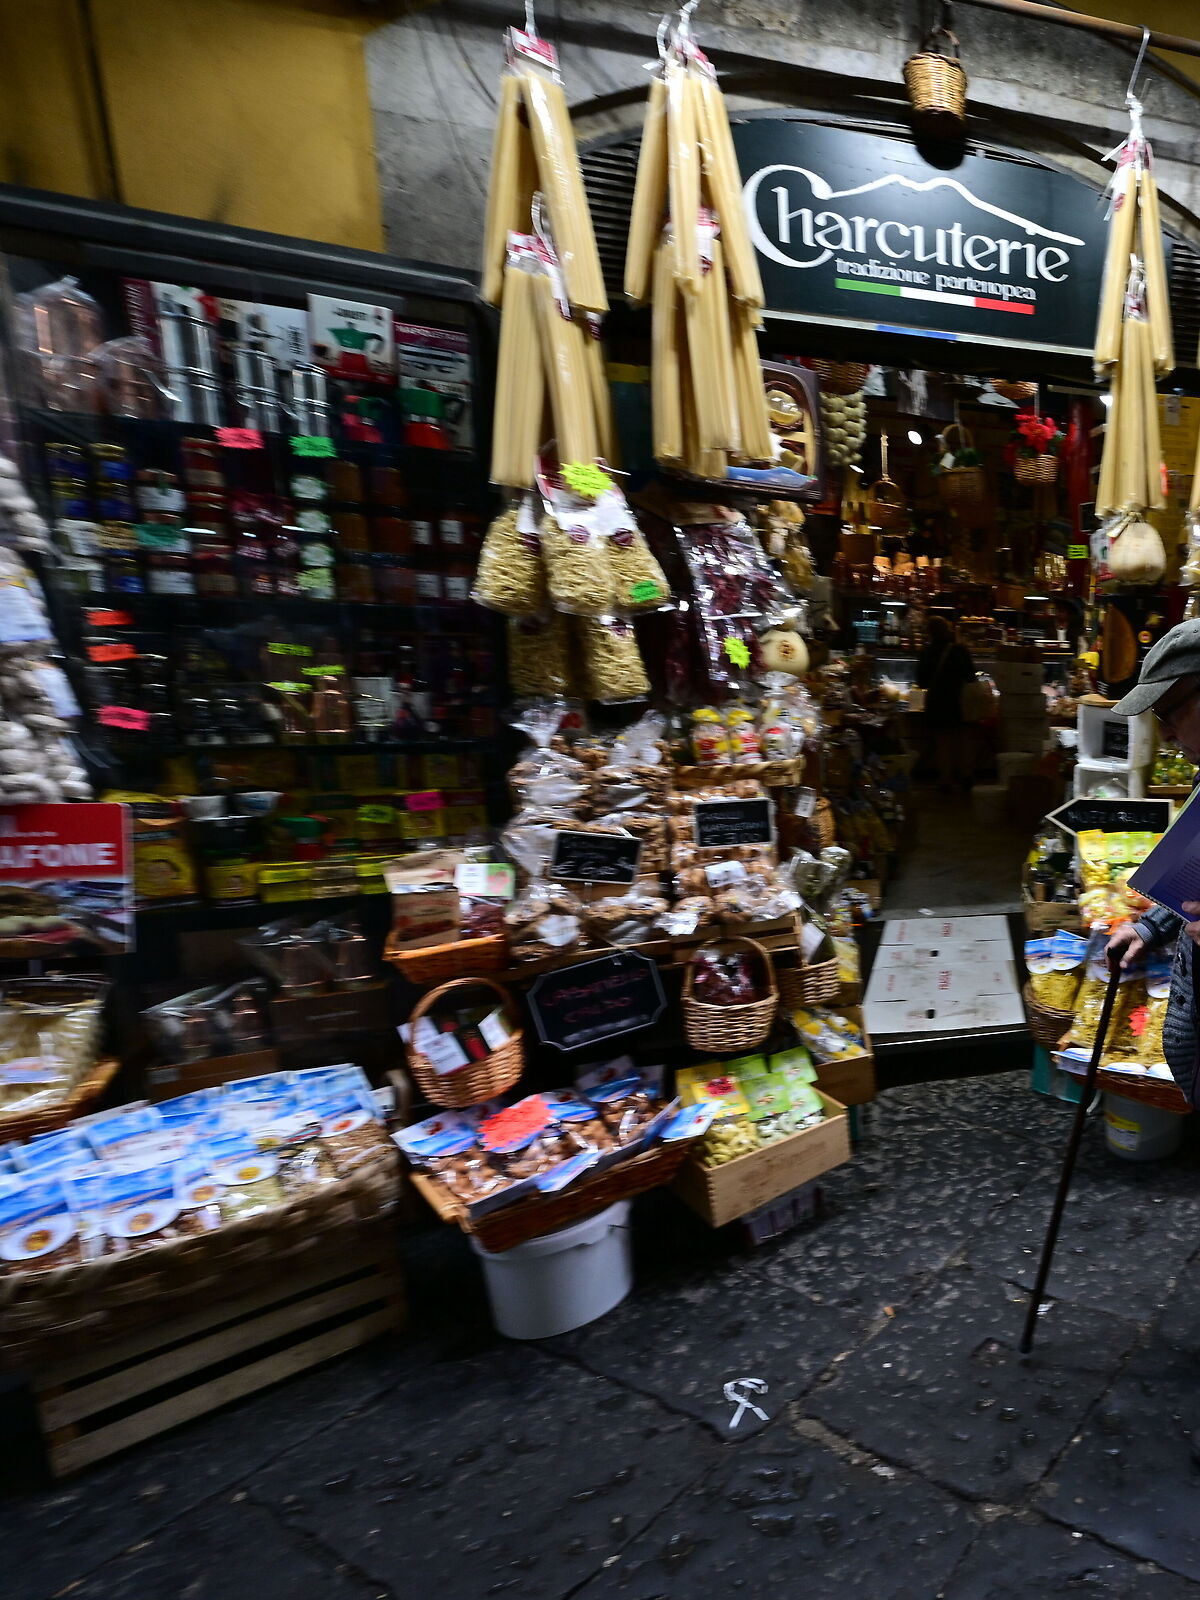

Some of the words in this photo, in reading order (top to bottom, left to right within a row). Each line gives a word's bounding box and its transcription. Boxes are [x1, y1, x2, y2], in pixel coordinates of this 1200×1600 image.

[742, 164, 1070, 282] Charcuterie
[834, 257, 931, 286] tradizione
[934, 273, 1037, 301] partenopea
